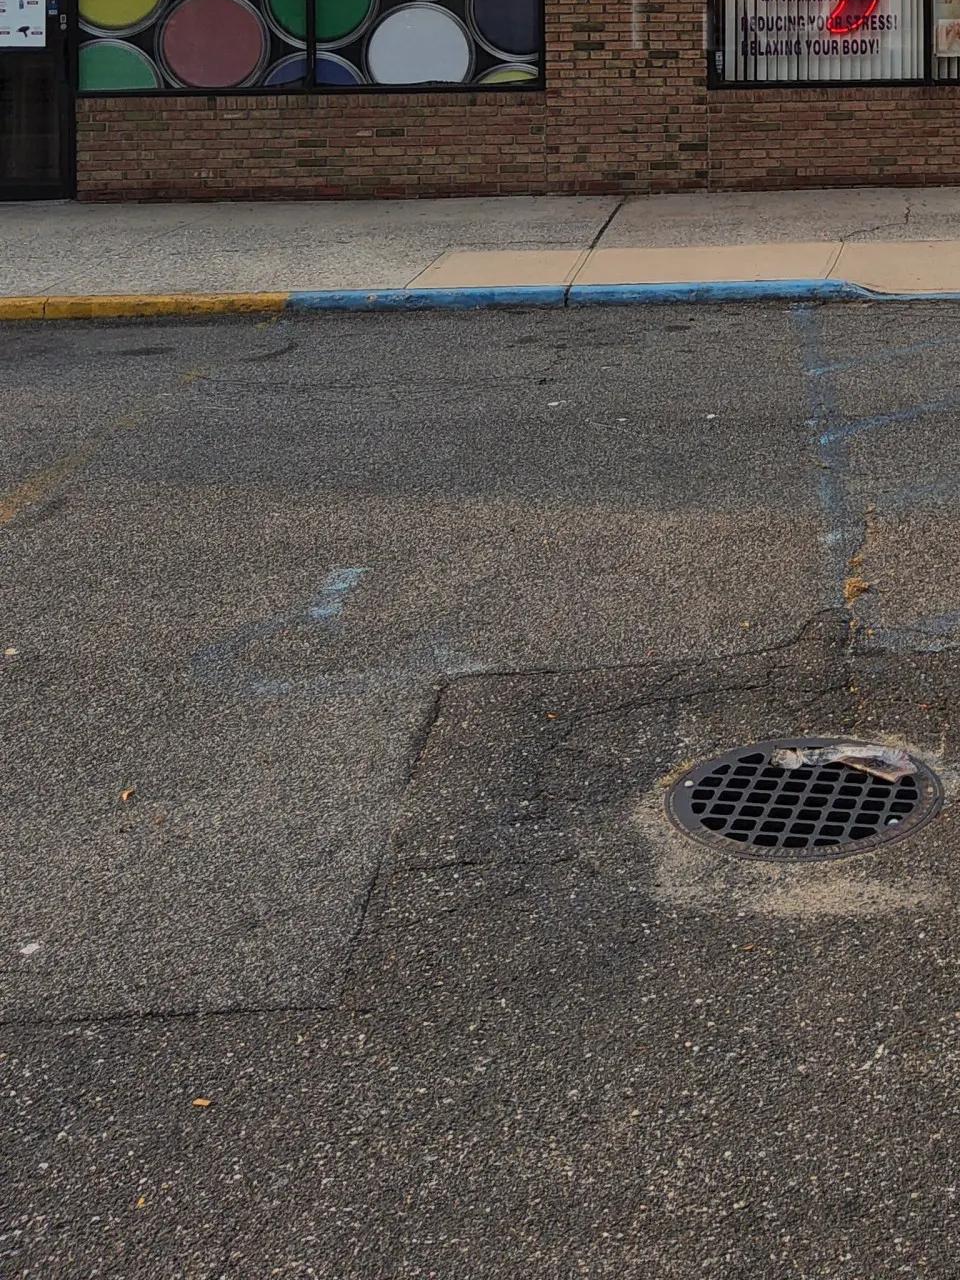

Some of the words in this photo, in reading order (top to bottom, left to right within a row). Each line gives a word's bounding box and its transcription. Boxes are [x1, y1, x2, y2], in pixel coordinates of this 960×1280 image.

[741, 15, 806, 33] REDUCING
[808, 15, 842, 32] YOUR
[846, 14, 898, 31] STRESS!
[741, 39, 804, 56] RELAXING
[805, 39, 840, 55] YOUR
[842, 39, 880, 56] BODY!
